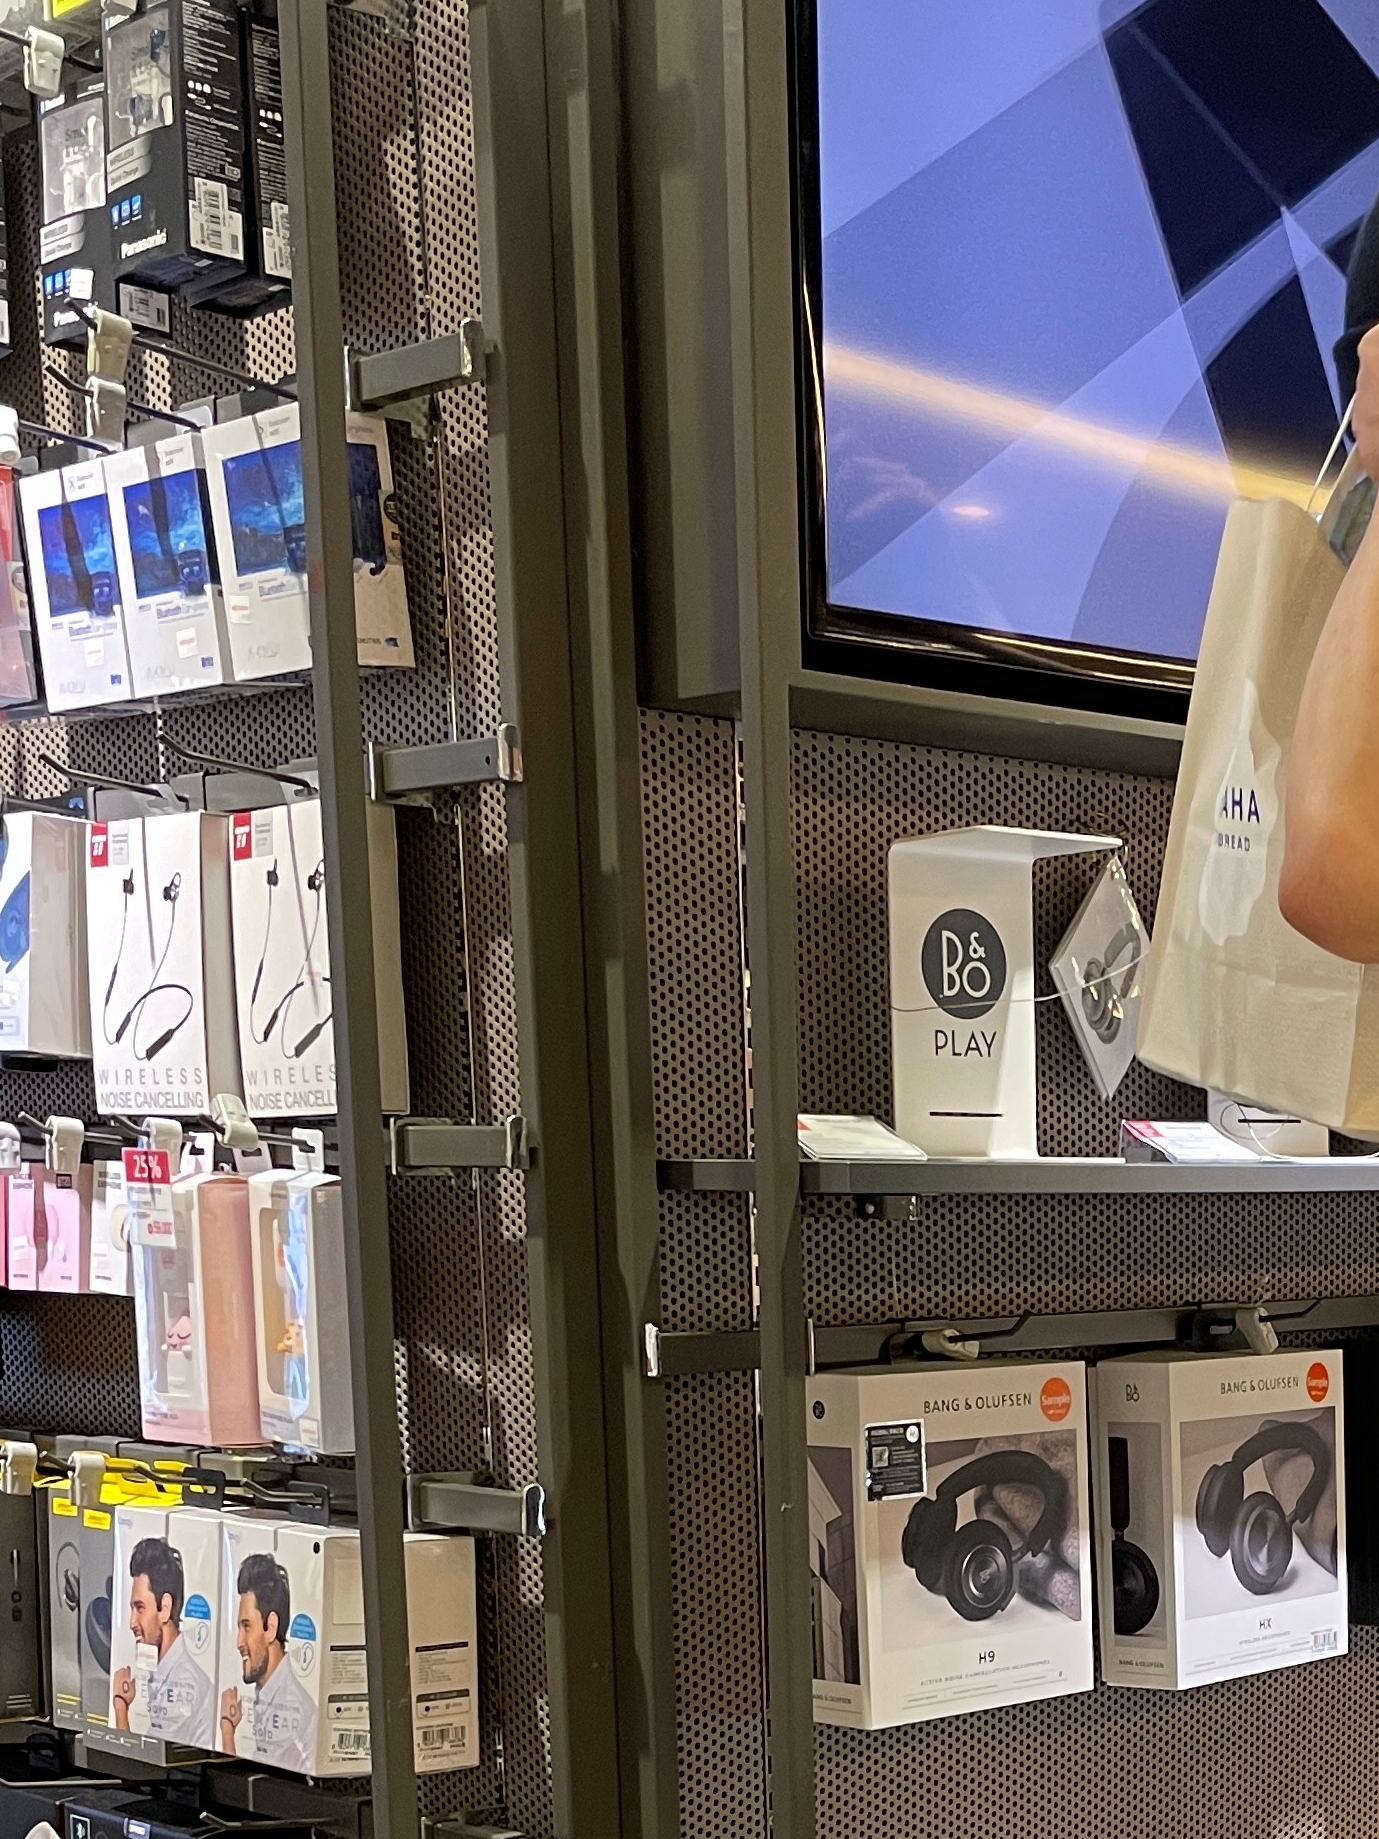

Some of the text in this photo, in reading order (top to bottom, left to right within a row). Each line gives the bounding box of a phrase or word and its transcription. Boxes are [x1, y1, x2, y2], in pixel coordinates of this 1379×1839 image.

[934, 1029, 997, 1057] PLAY
[99, 1067, 203, 1085] WIRELESS
[101, 1091, 204, 1109] NOISE CANCELLING
[249, 1090, 283, 1110] NOISE
[133, 1154, 162, 1179] 25%
[1220, 1376, 1299, 1395] BANG & OLUFSEN
[923, 1393, 1032, 1414] BANG & OLUFSEN
[1259, 1618, 1272, 1630] HX
[978, 1650, 995, 1664] H9
